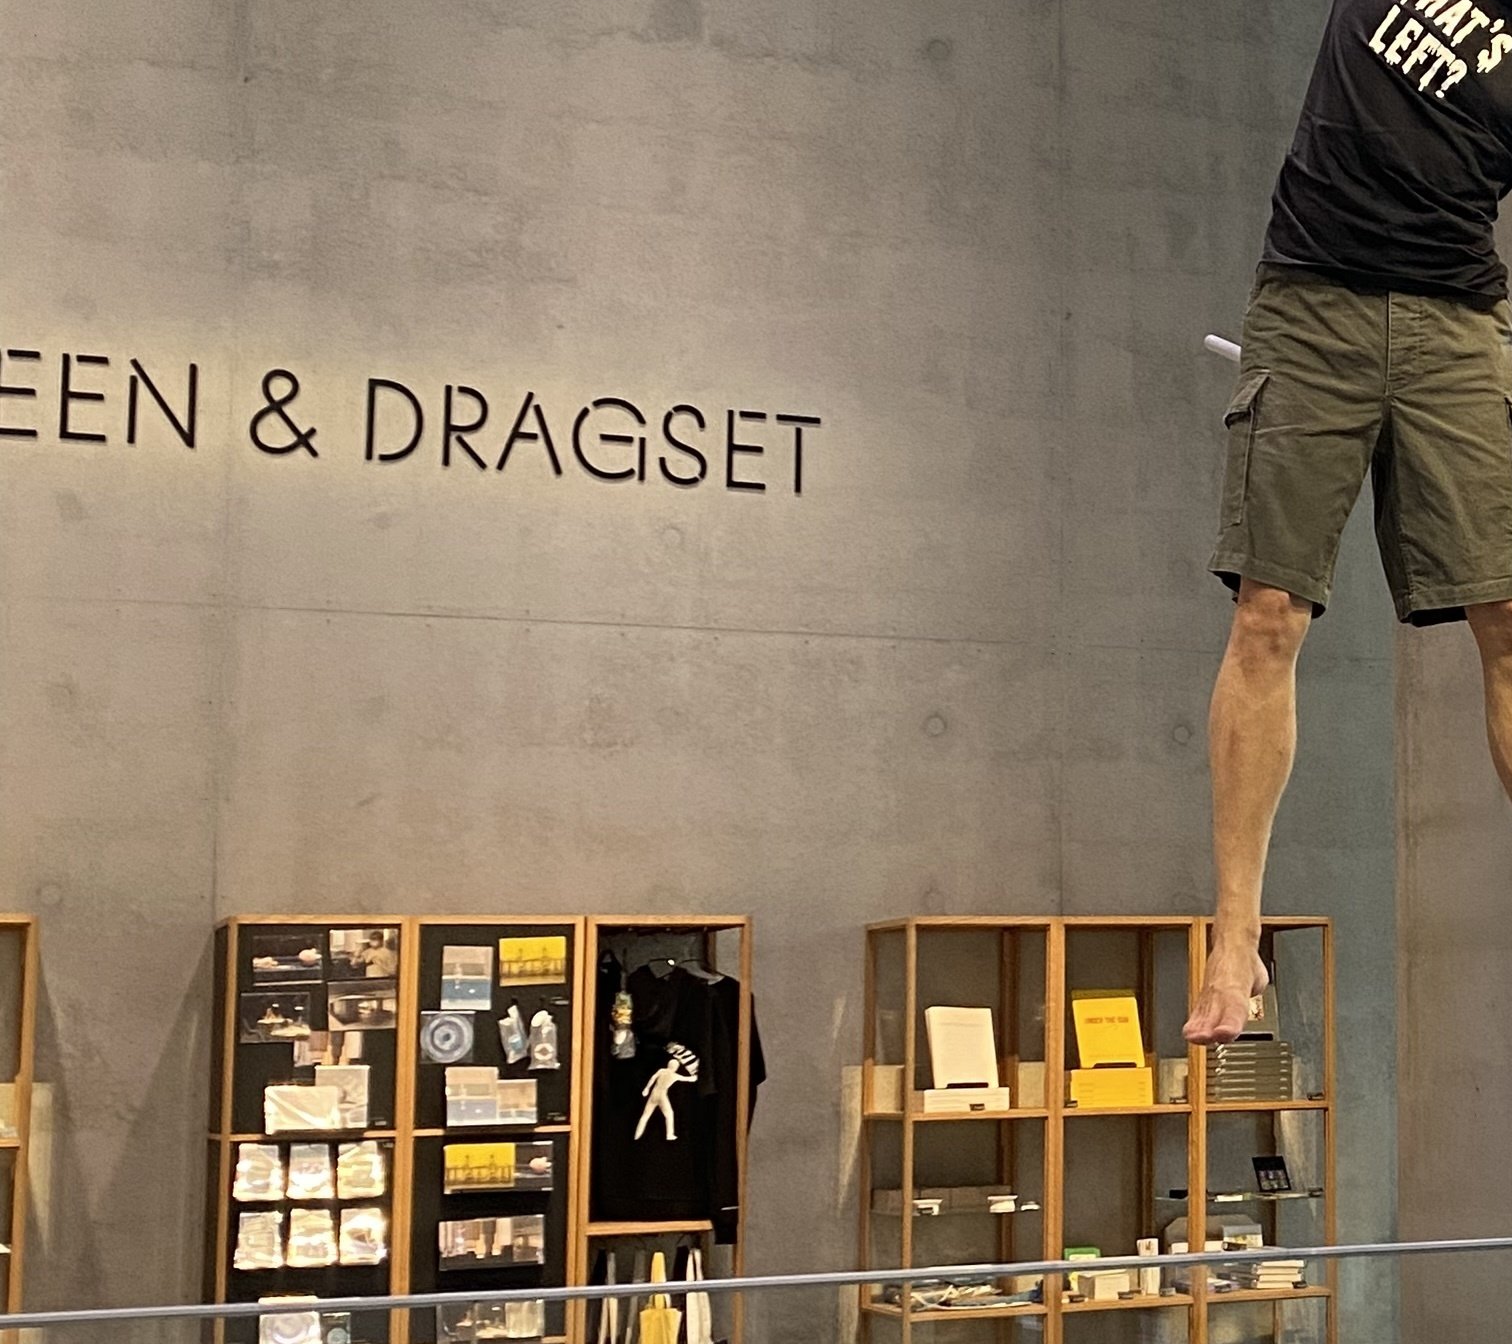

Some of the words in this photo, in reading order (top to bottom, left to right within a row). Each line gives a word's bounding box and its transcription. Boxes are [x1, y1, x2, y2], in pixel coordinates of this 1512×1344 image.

[1368, 4, 1468, 98] LEFT?
[249, 368, 320, 459] &
[364, 377, 822, 495] DRAGSET
